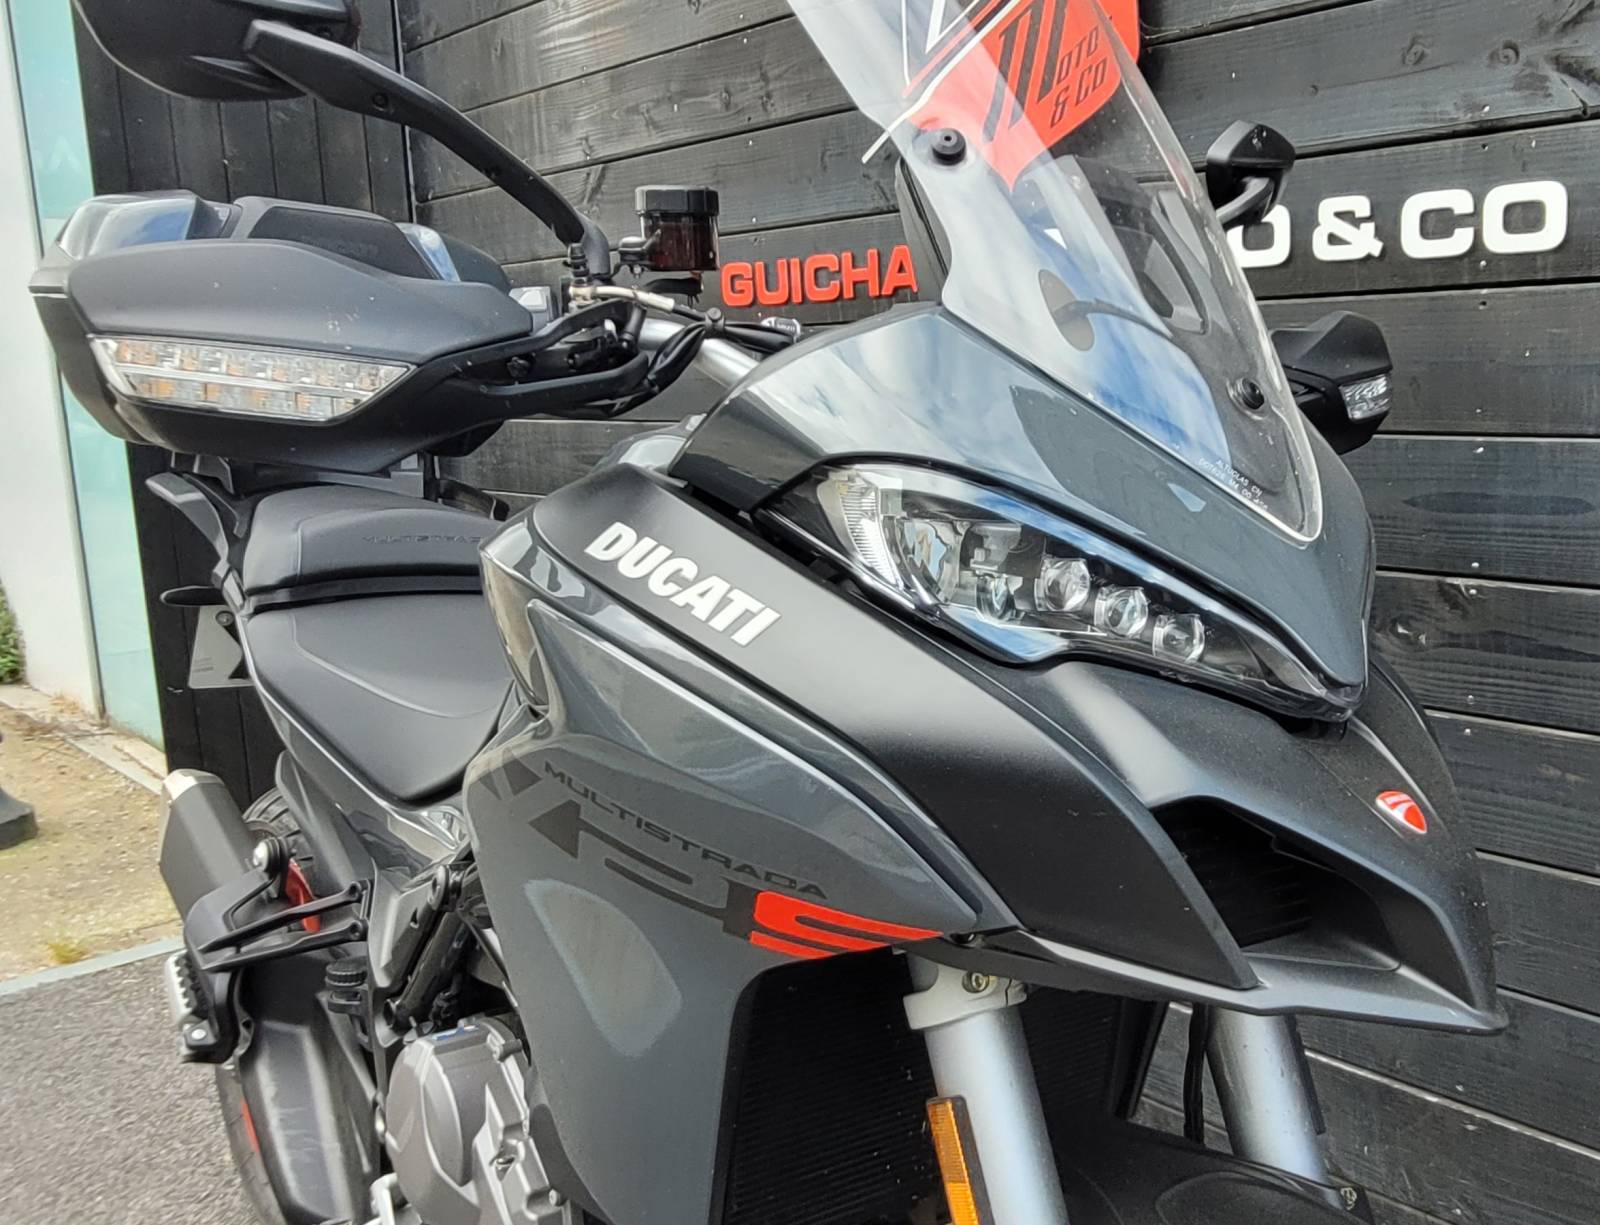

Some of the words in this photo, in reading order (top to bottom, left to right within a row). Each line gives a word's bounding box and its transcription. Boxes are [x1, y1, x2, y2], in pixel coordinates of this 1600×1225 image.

[1051, 87, 1072, 129] &
[1075, 56, 1109, 108] CO
[1311, 194, 1384, 262] &
[1400, 180, 1568, 260] CO
[720, 244, 918, 308] GUICHA
[583, 521, 782, 647] DUCATI
[543, 760, 828, 899] MULTISTRADA
